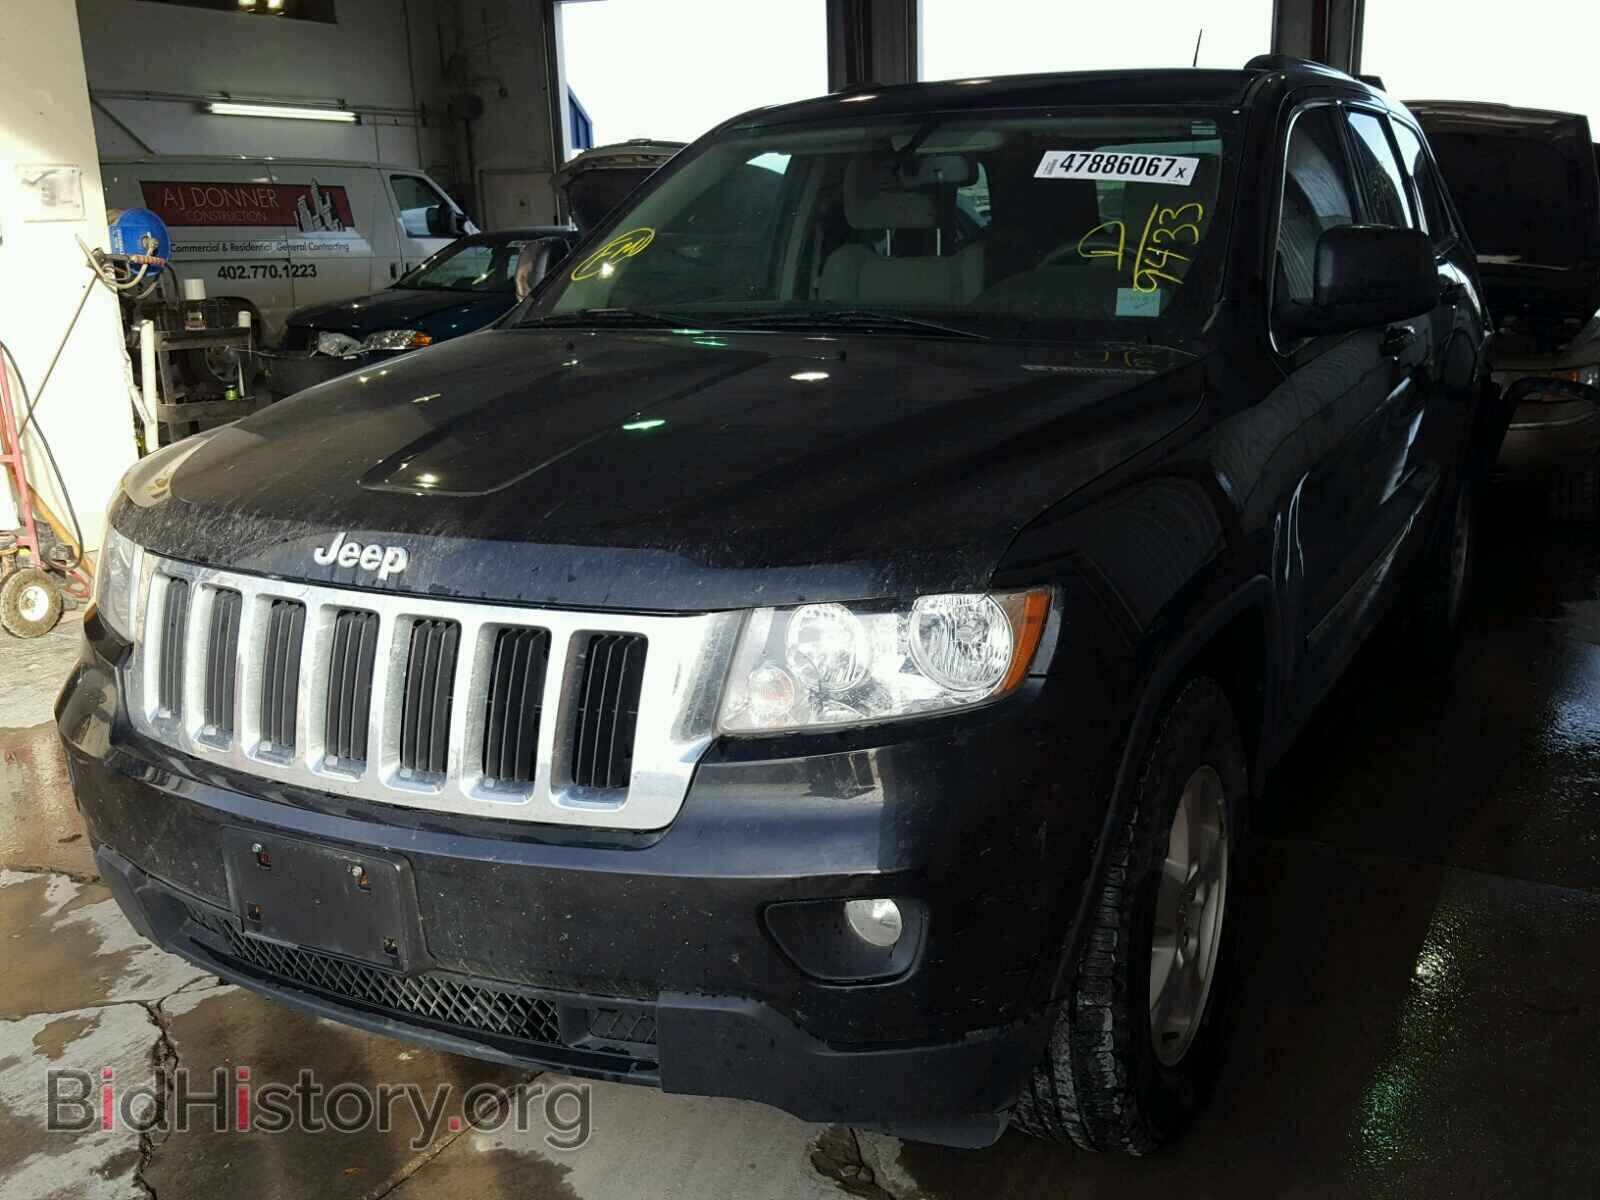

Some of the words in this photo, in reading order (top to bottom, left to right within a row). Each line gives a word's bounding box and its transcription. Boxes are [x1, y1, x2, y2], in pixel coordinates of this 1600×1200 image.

[192, 186, 280, 209] DONNER
[171, 243, 220, 253] Commercial
[230, 242, 273, 252] Residentia
[277, 241, 306, 252] General
[308, 241, 350, 252] Contracting
[218, 264, 318, 280] 402.770.1223
[313, 531, 409, 581] Jeep
